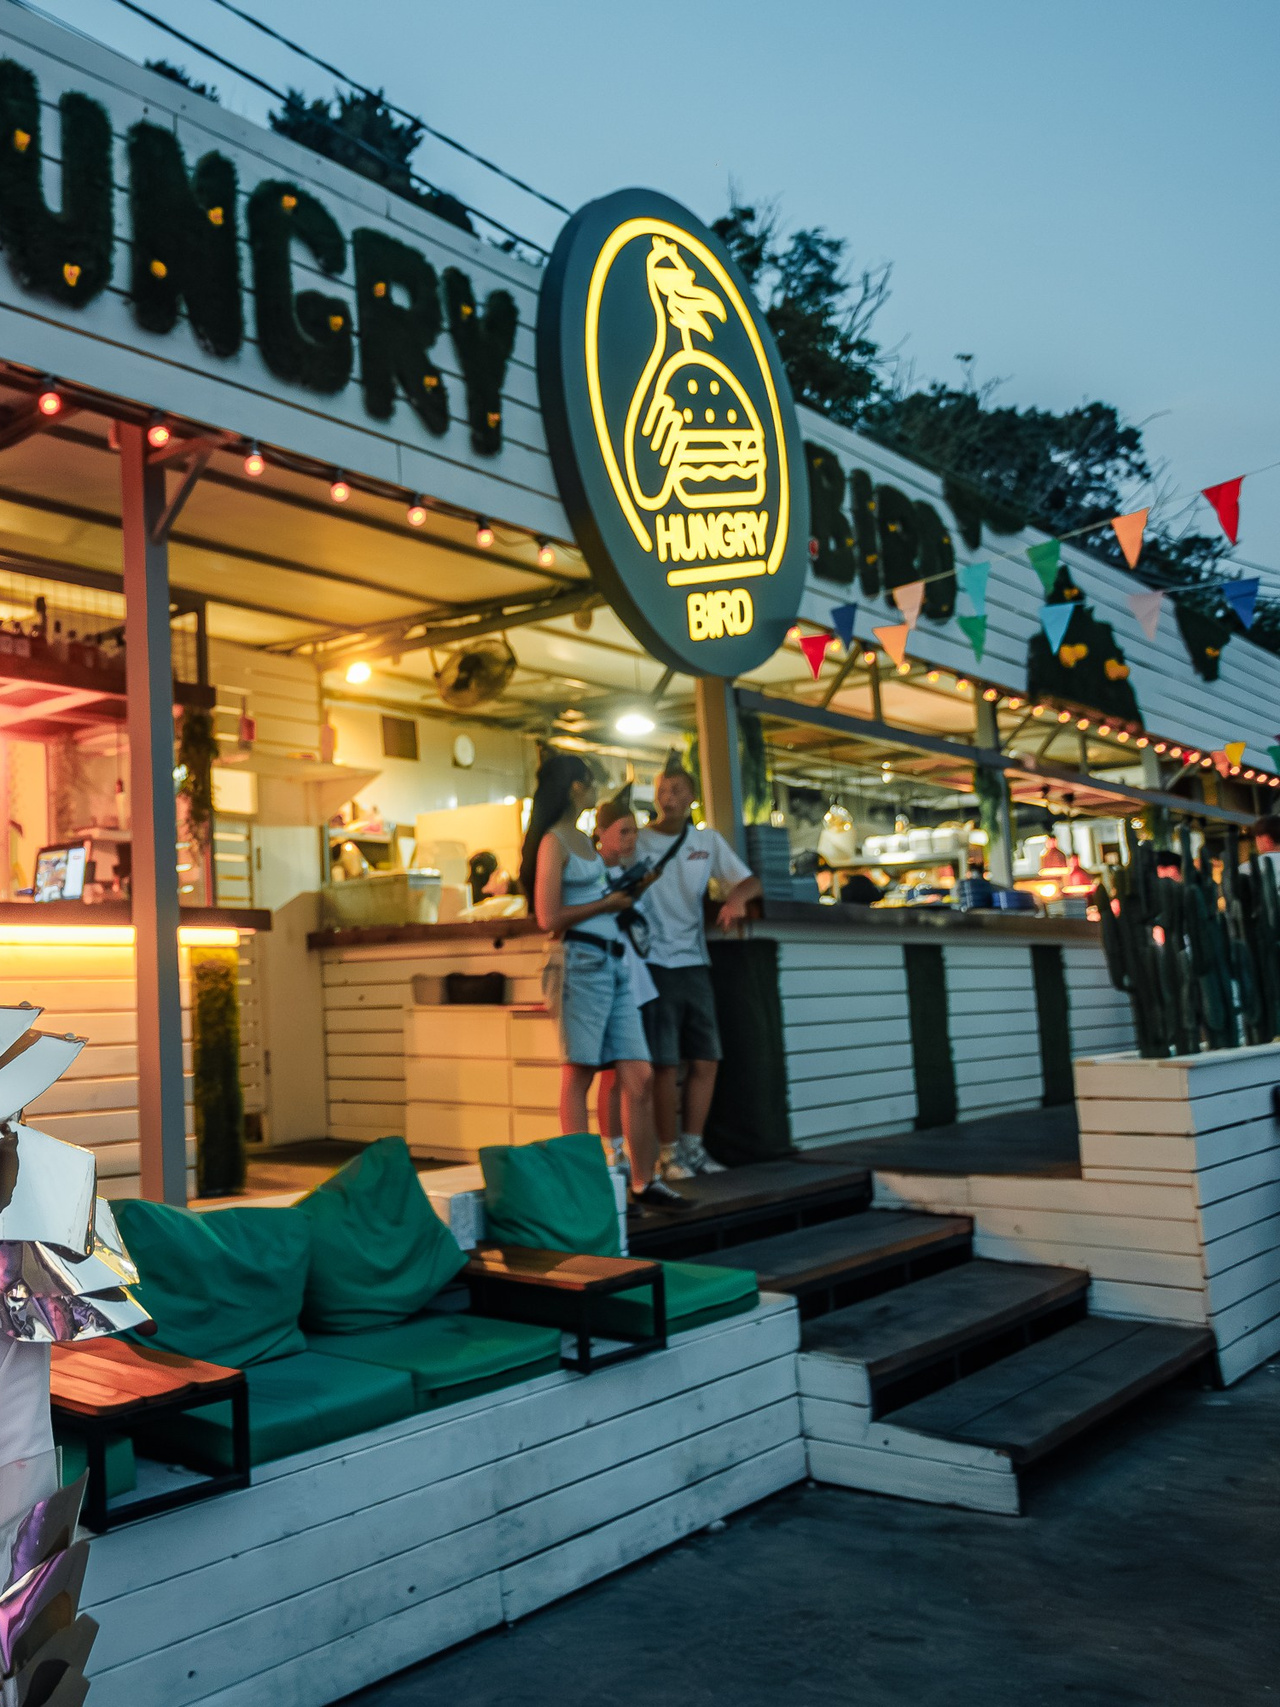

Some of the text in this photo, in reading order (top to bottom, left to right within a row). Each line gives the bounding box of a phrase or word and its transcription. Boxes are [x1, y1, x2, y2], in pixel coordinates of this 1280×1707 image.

[655, 510, 769, 563] HUNGRY
[803, 440, 956, 626] BIRD
[686, 587, 755, 642] BIRD
